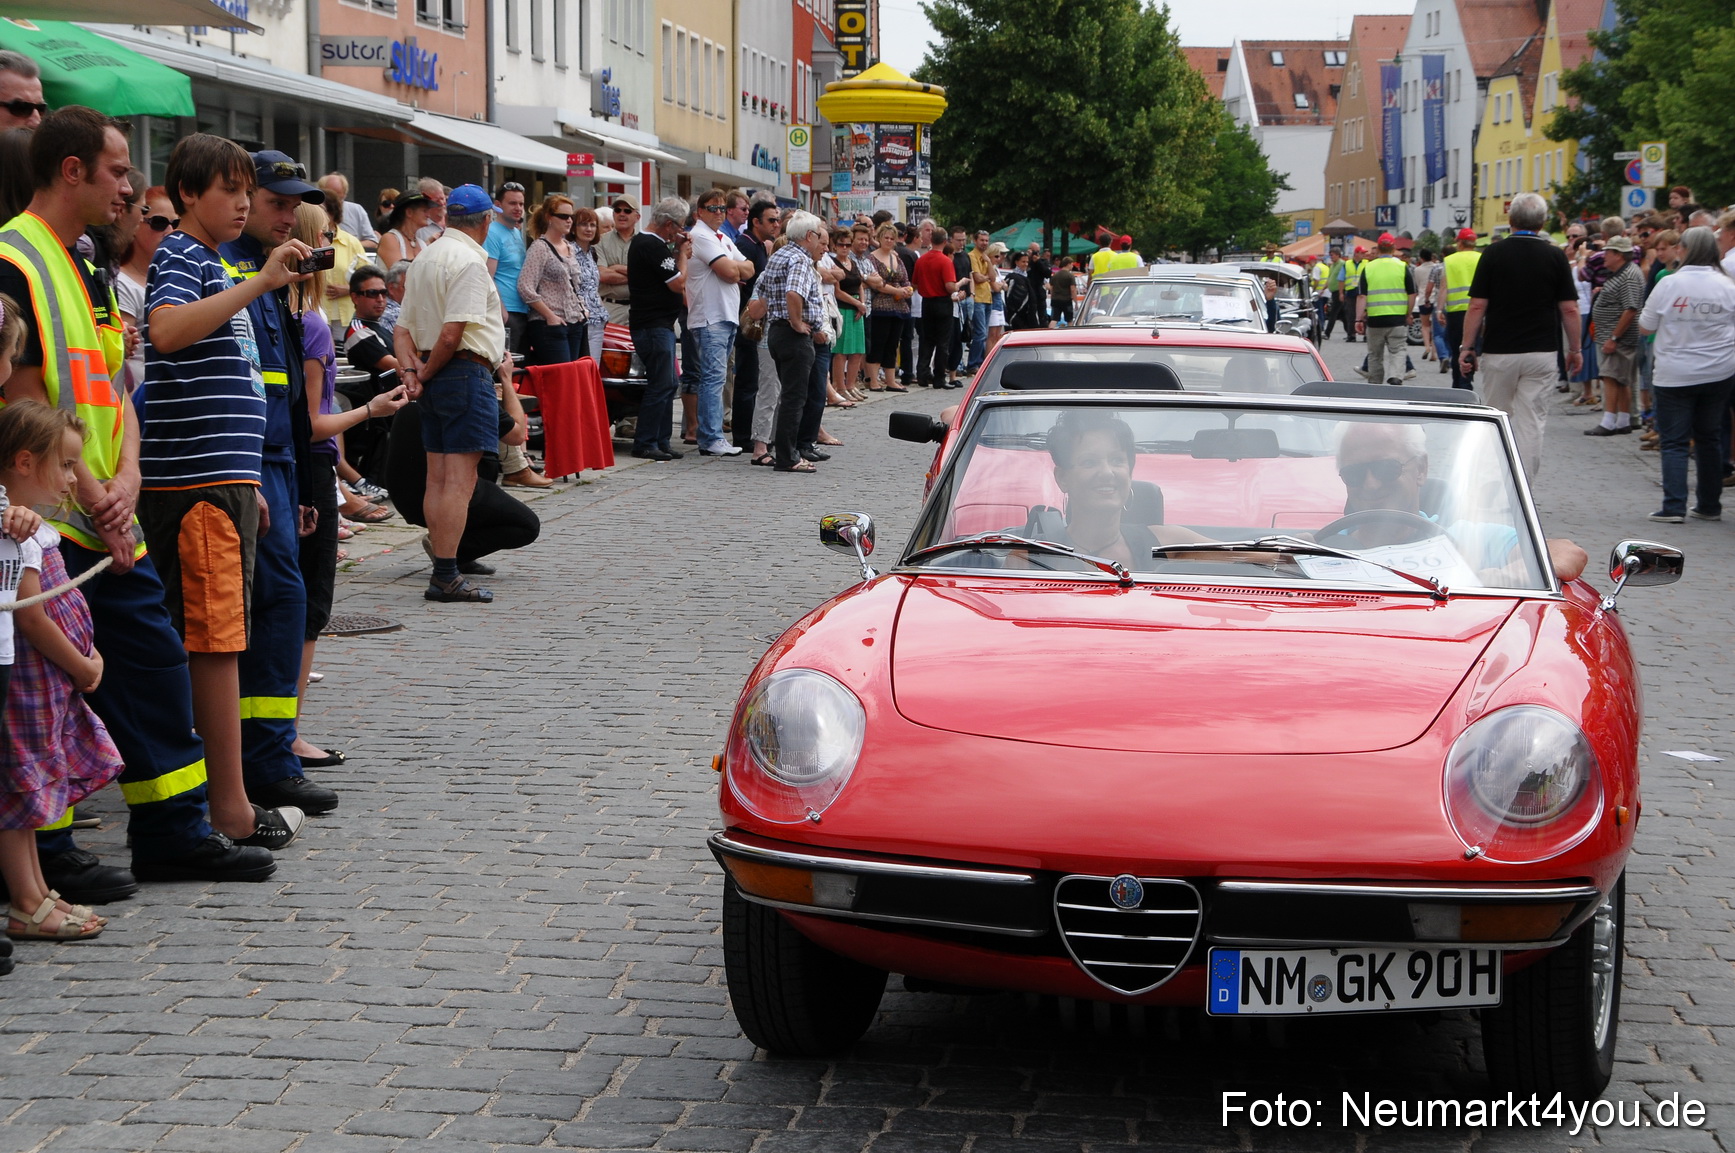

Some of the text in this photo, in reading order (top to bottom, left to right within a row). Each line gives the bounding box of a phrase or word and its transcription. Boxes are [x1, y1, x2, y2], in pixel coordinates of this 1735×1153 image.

[321, 40, 385, 60] sutor.
[1241, 950, 1497, 1005] NM GK 90H
[1218, 988, 1229, 1002] D
